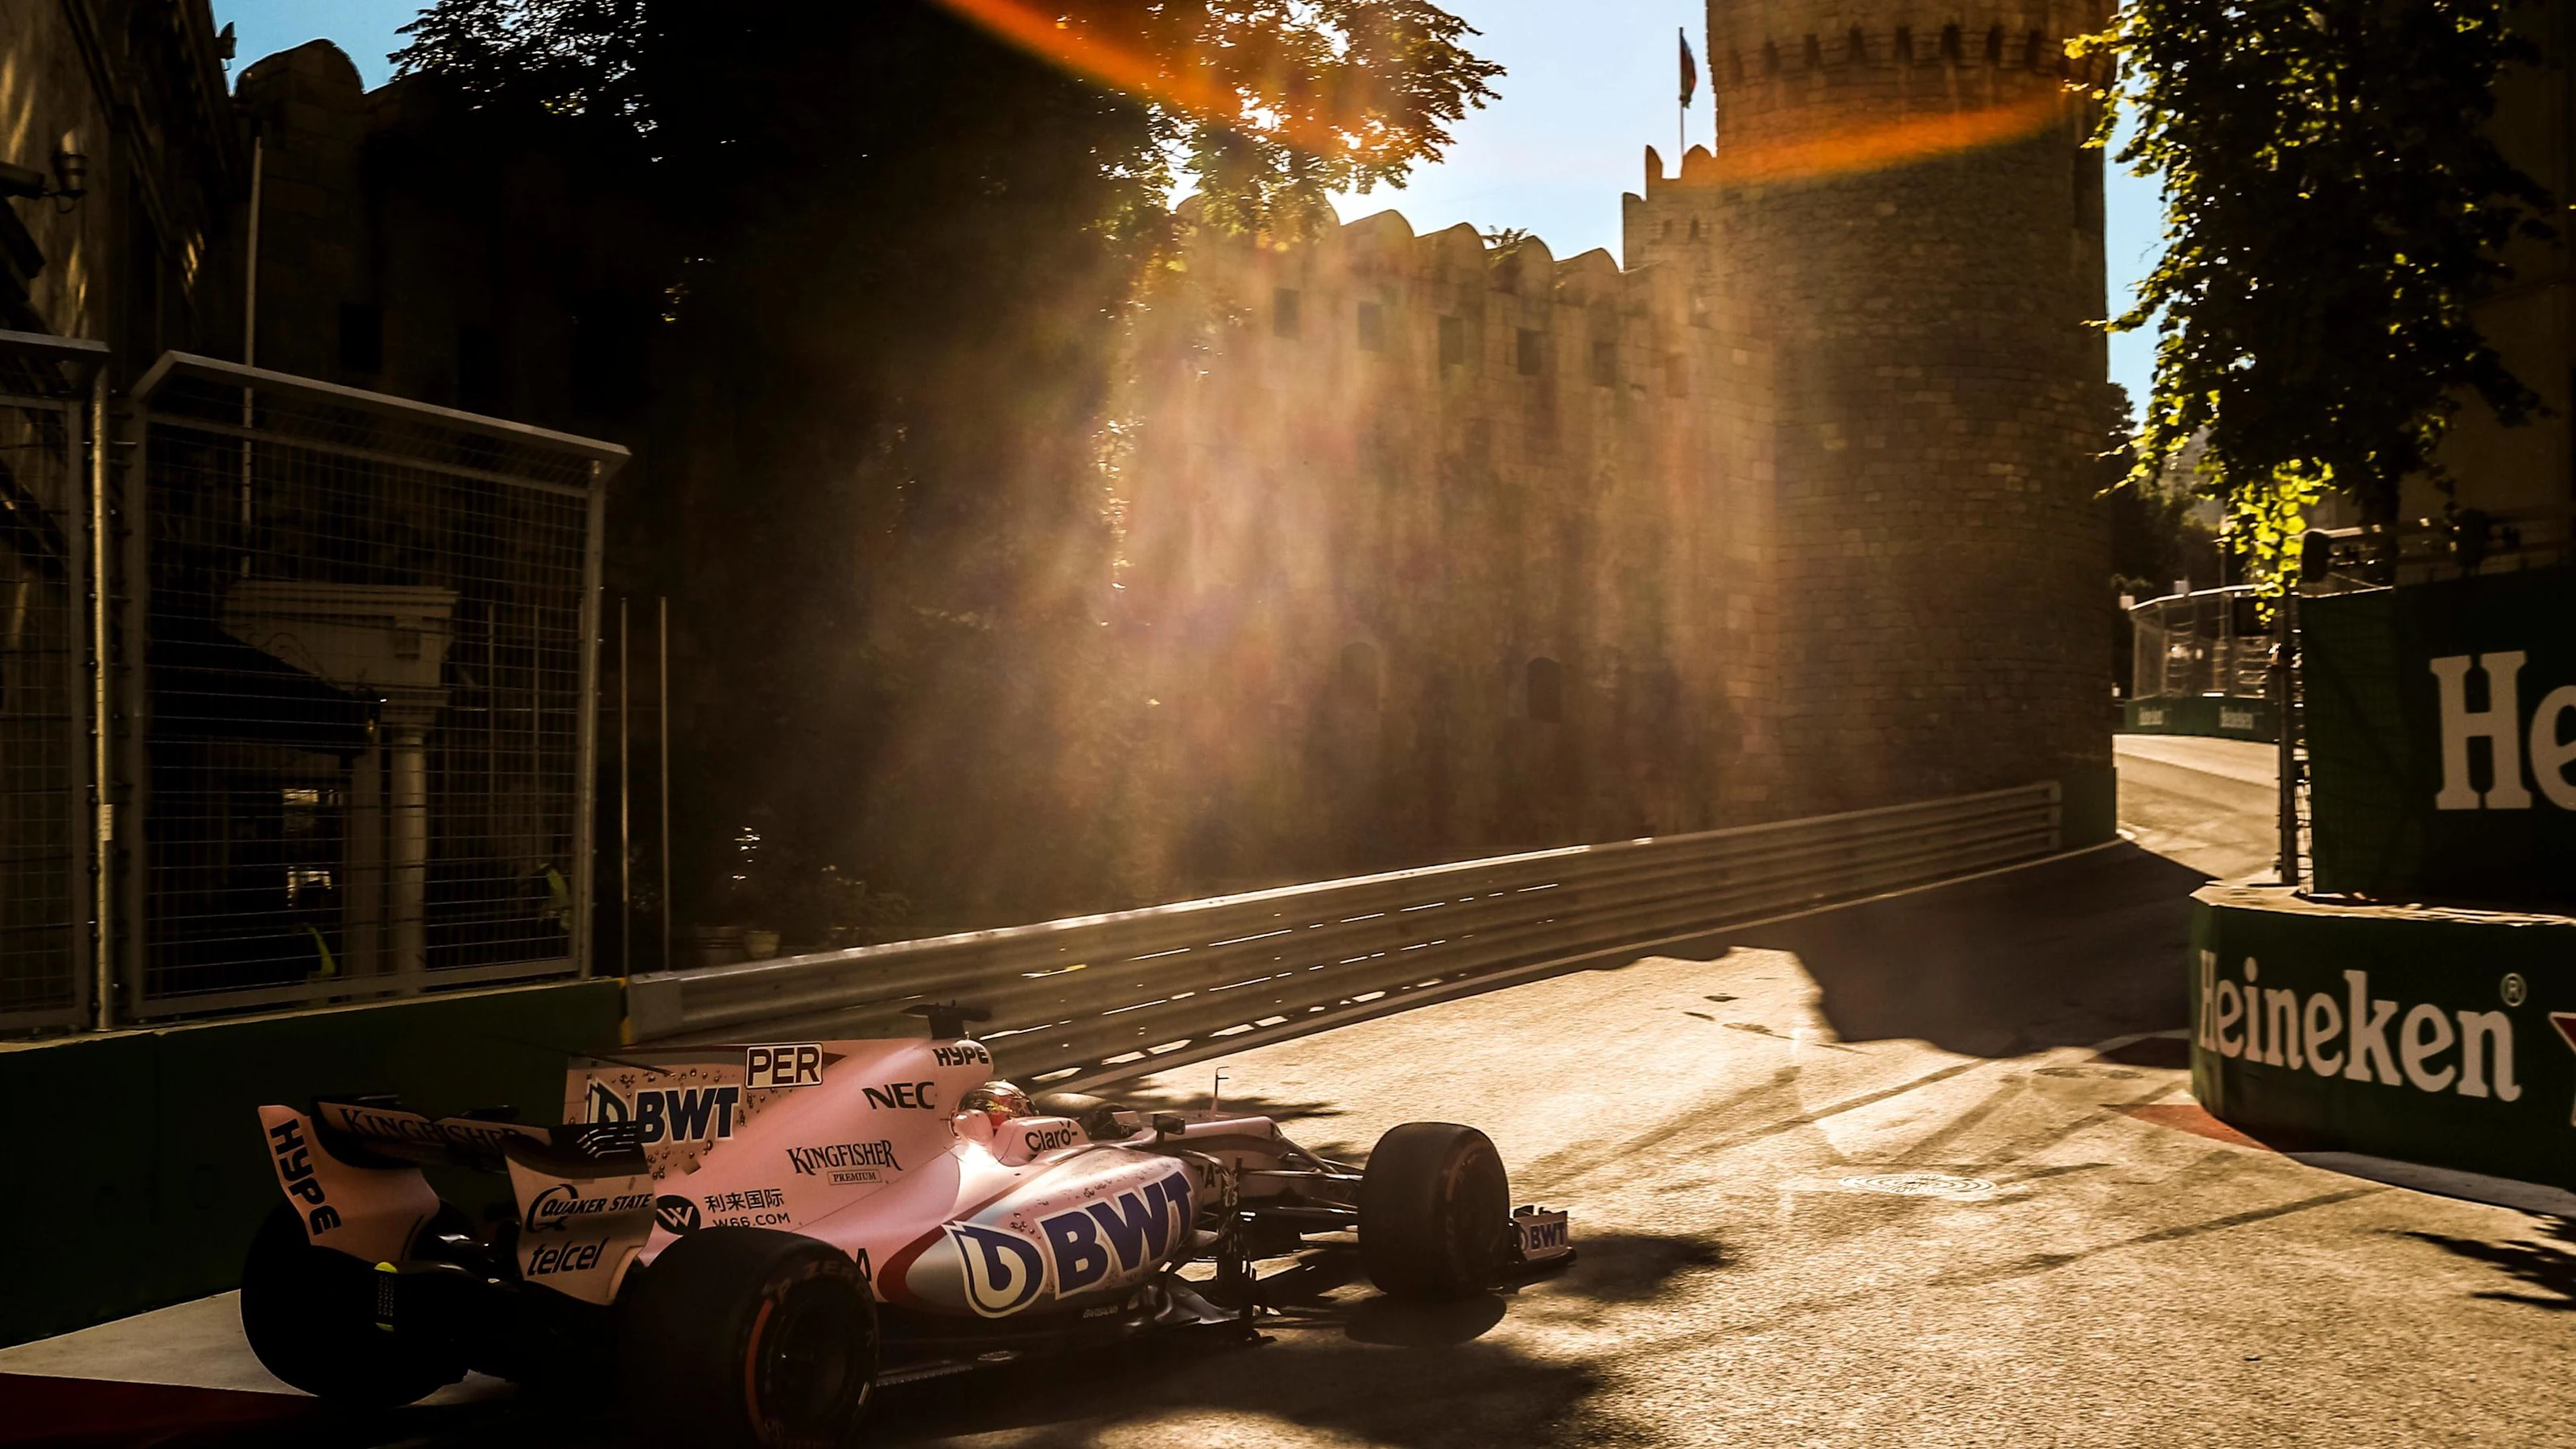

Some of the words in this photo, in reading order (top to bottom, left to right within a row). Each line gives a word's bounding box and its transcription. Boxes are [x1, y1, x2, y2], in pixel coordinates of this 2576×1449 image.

[747, 1047, 819, 1086] PER
[933, 1046, 989, 1066] HYPE
[862, 1081, 935, 1109] NEC
[637, 1087, 739, 1143] BWT
[787, 1140, 903, 1175] KINGFISHER
[270, 1119, 342, 1236] HYPE
[833, 1172, 877, 1182] PREMIUM
[541, 1197, 607, 1217] QUAKER
[609, 1194, 653, 1211] STATE
[704, 1188, 785, 1213] 利来国际
[712, 1212, 791, 1228] W66.COM
[1040, 1171, 1191, 1293] BWT
[1530, 1222, 1565, 1249] BWT
[527, 1236, 611, 1276] telcel
